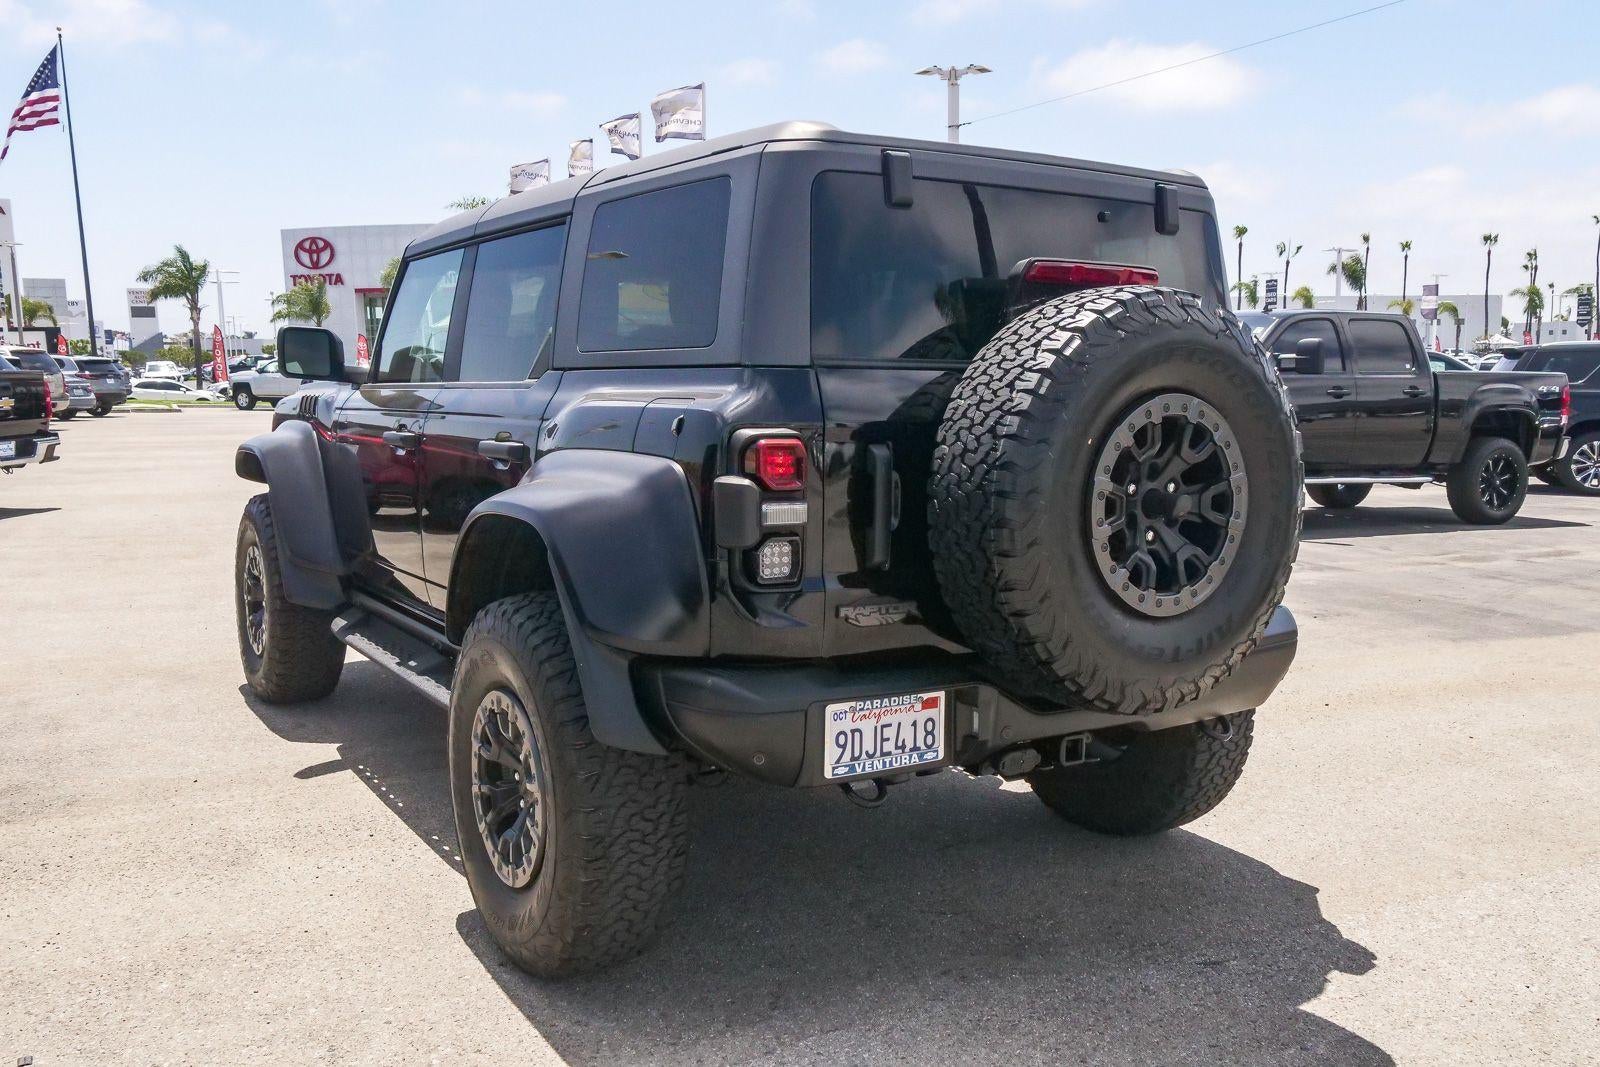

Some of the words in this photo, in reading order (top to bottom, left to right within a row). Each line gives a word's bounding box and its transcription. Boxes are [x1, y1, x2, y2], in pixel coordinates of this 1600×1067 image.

[856, 694, 918, 712] PARADISE
[832, 711, 848, 722] OCT
[851, 703, 921, 724] California
[834, 717, 937, 765] 9DJE418
[854, 754, 920, 773] VENTURA
